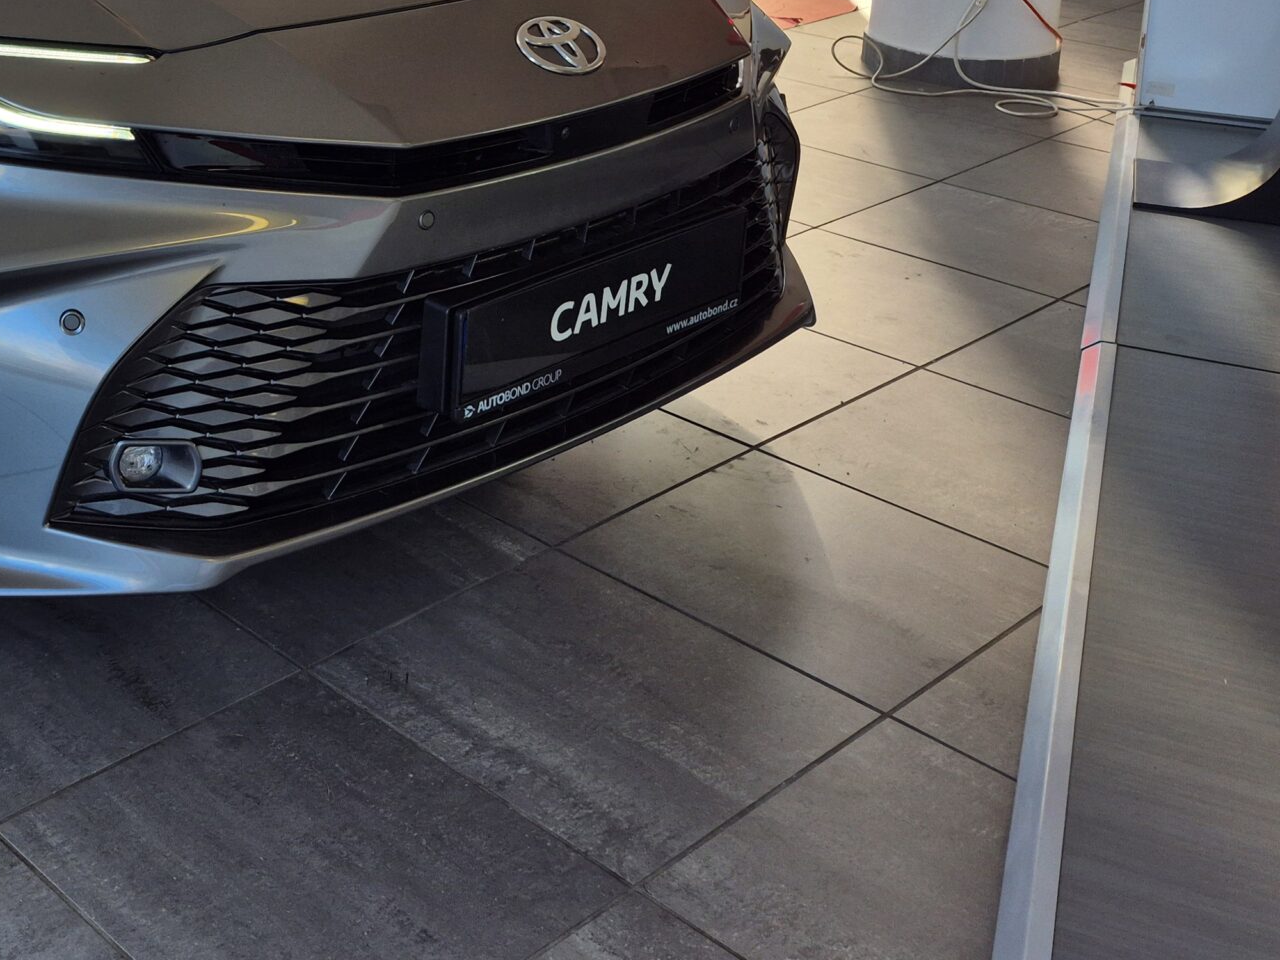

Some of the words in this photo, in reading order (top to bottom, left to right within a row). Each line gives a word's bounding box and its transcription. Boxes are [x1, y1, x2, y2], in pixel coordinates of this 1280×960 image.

[550, 263, 672, 342] CAMRY
[666, 298, 738, 335] www.autobond.cz
[477, 382, 531, 414] AUTOBOND
[532, 369, 562, 390] GROUP
